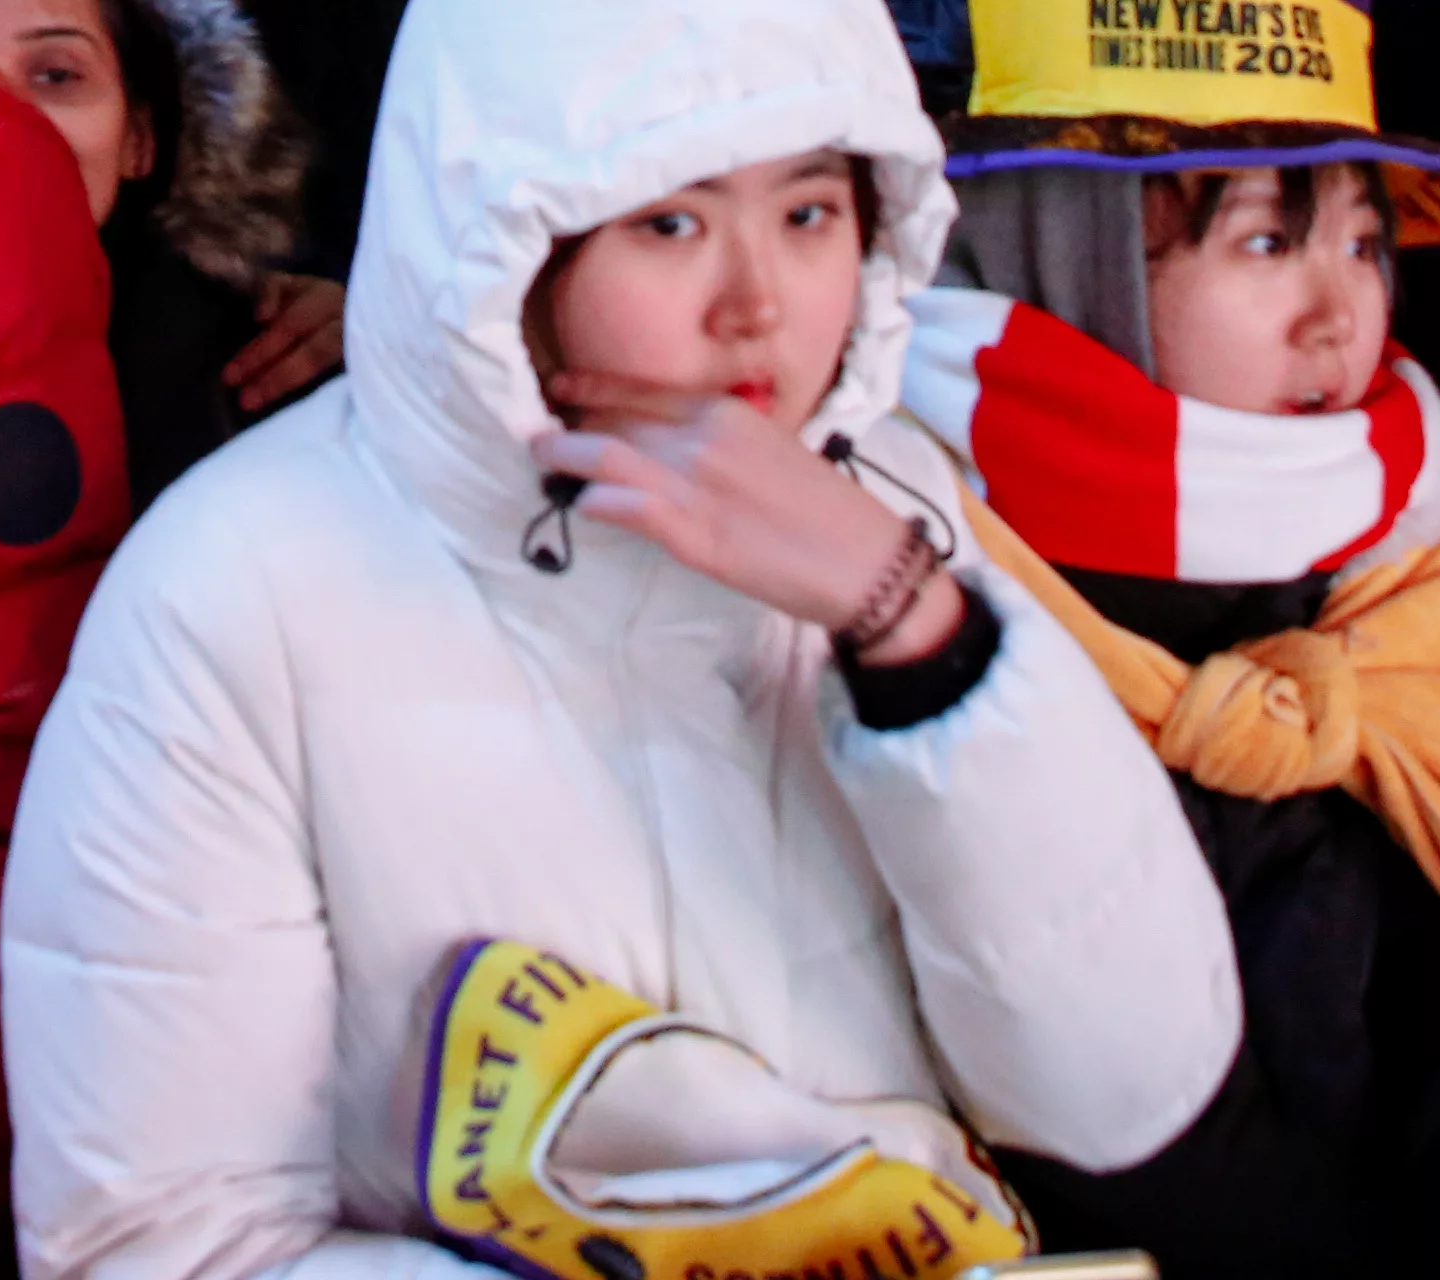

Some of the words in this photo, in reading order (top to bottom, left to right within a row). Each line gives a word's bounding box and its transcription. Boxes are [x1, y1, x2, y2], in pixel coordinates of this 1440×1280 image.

[1292, 7, 1325, 43] EVE
[1235, 42, 1334, 84] 2020
[454, 1035, 518, 1237] LANET
